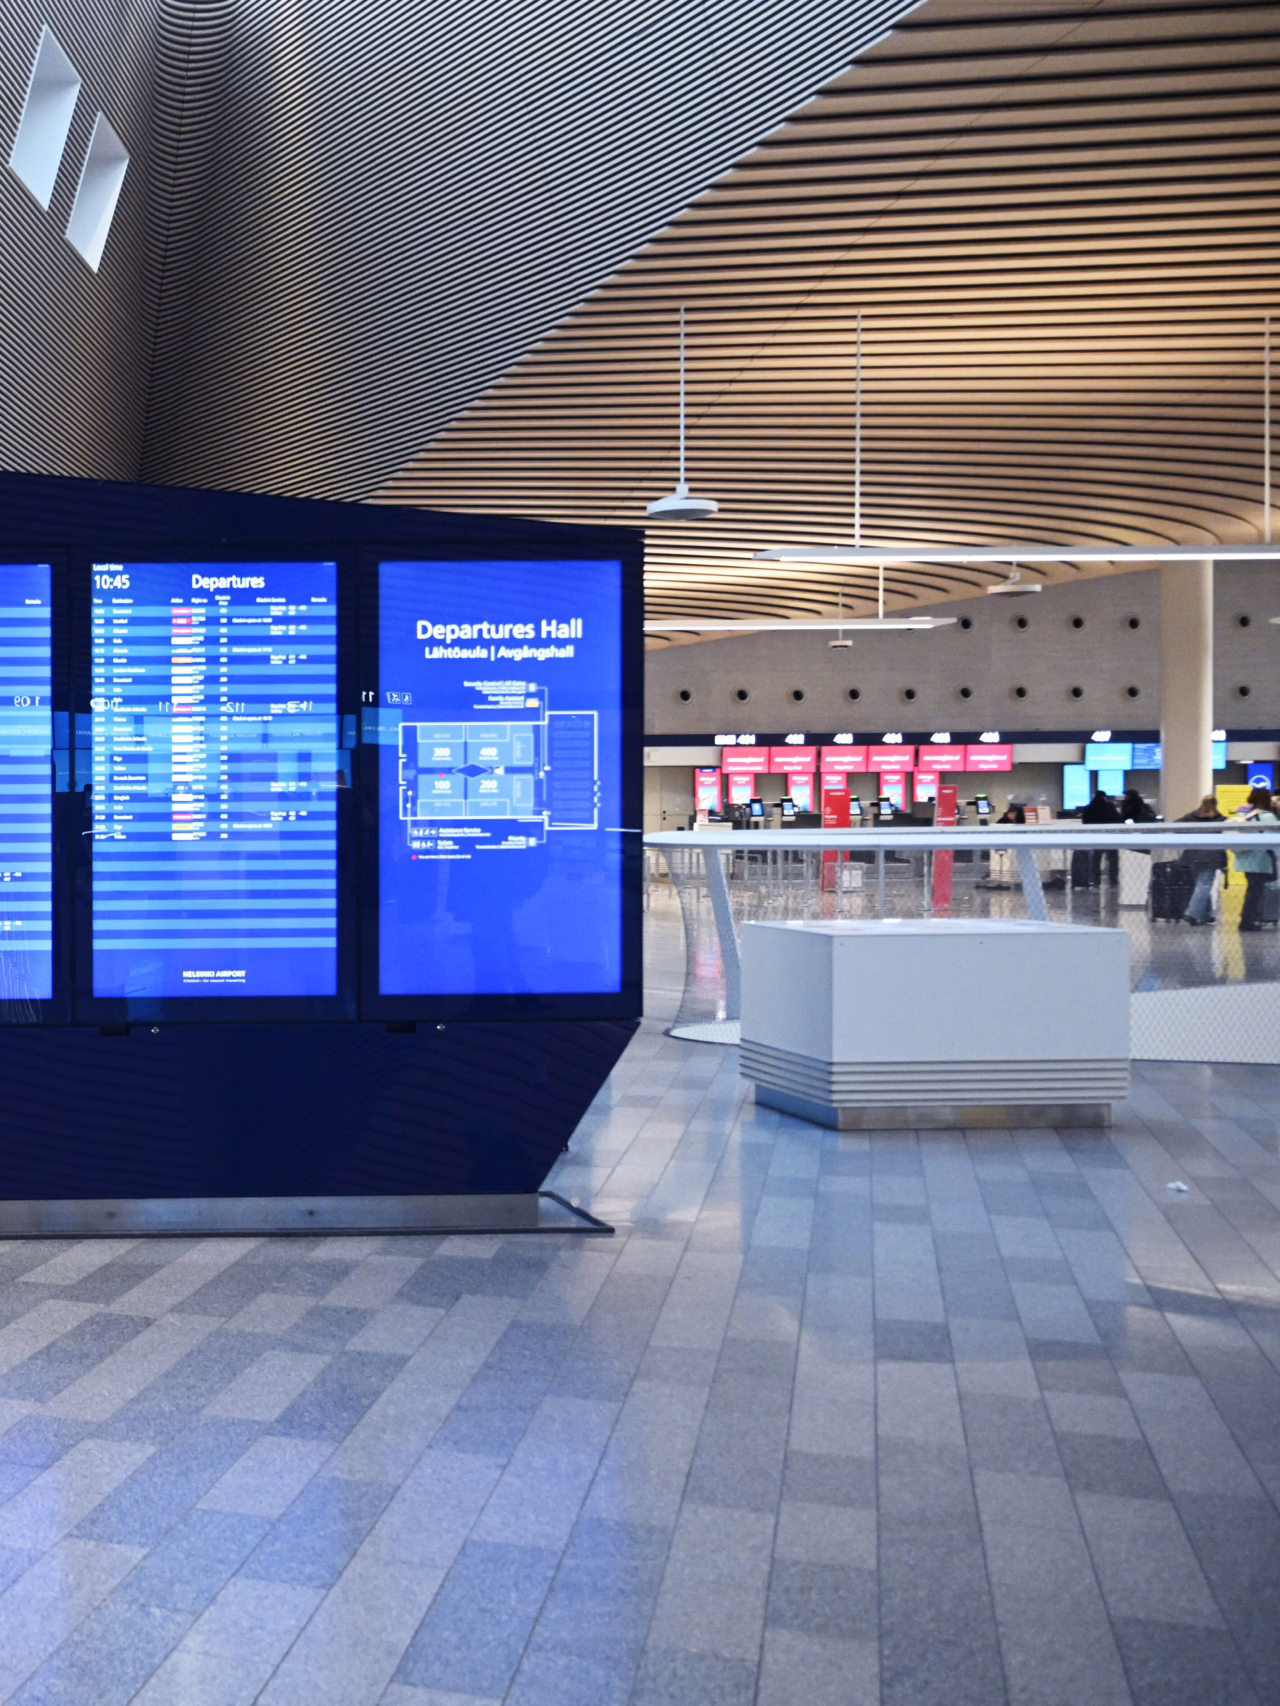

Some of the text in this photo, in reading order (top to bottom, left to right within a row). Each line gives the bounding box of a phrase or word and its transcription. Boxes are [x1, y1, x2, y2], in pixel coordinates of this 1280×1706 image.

[94, 575, 130, 589] 10:45
[192, 574, 265, 592] Departures
[416, 618, 583, 644] Departures Hall
[425, 646, 488, 659] Lähtöaula
[497, 645, 574, 661] Avgångshall
[480, 747, 498, 757] 400
[434, 780, 451, 790] 100
[480, 780, 498, 790] 200
[182, 970, 246, 978] HELSINKI AIRPORT
